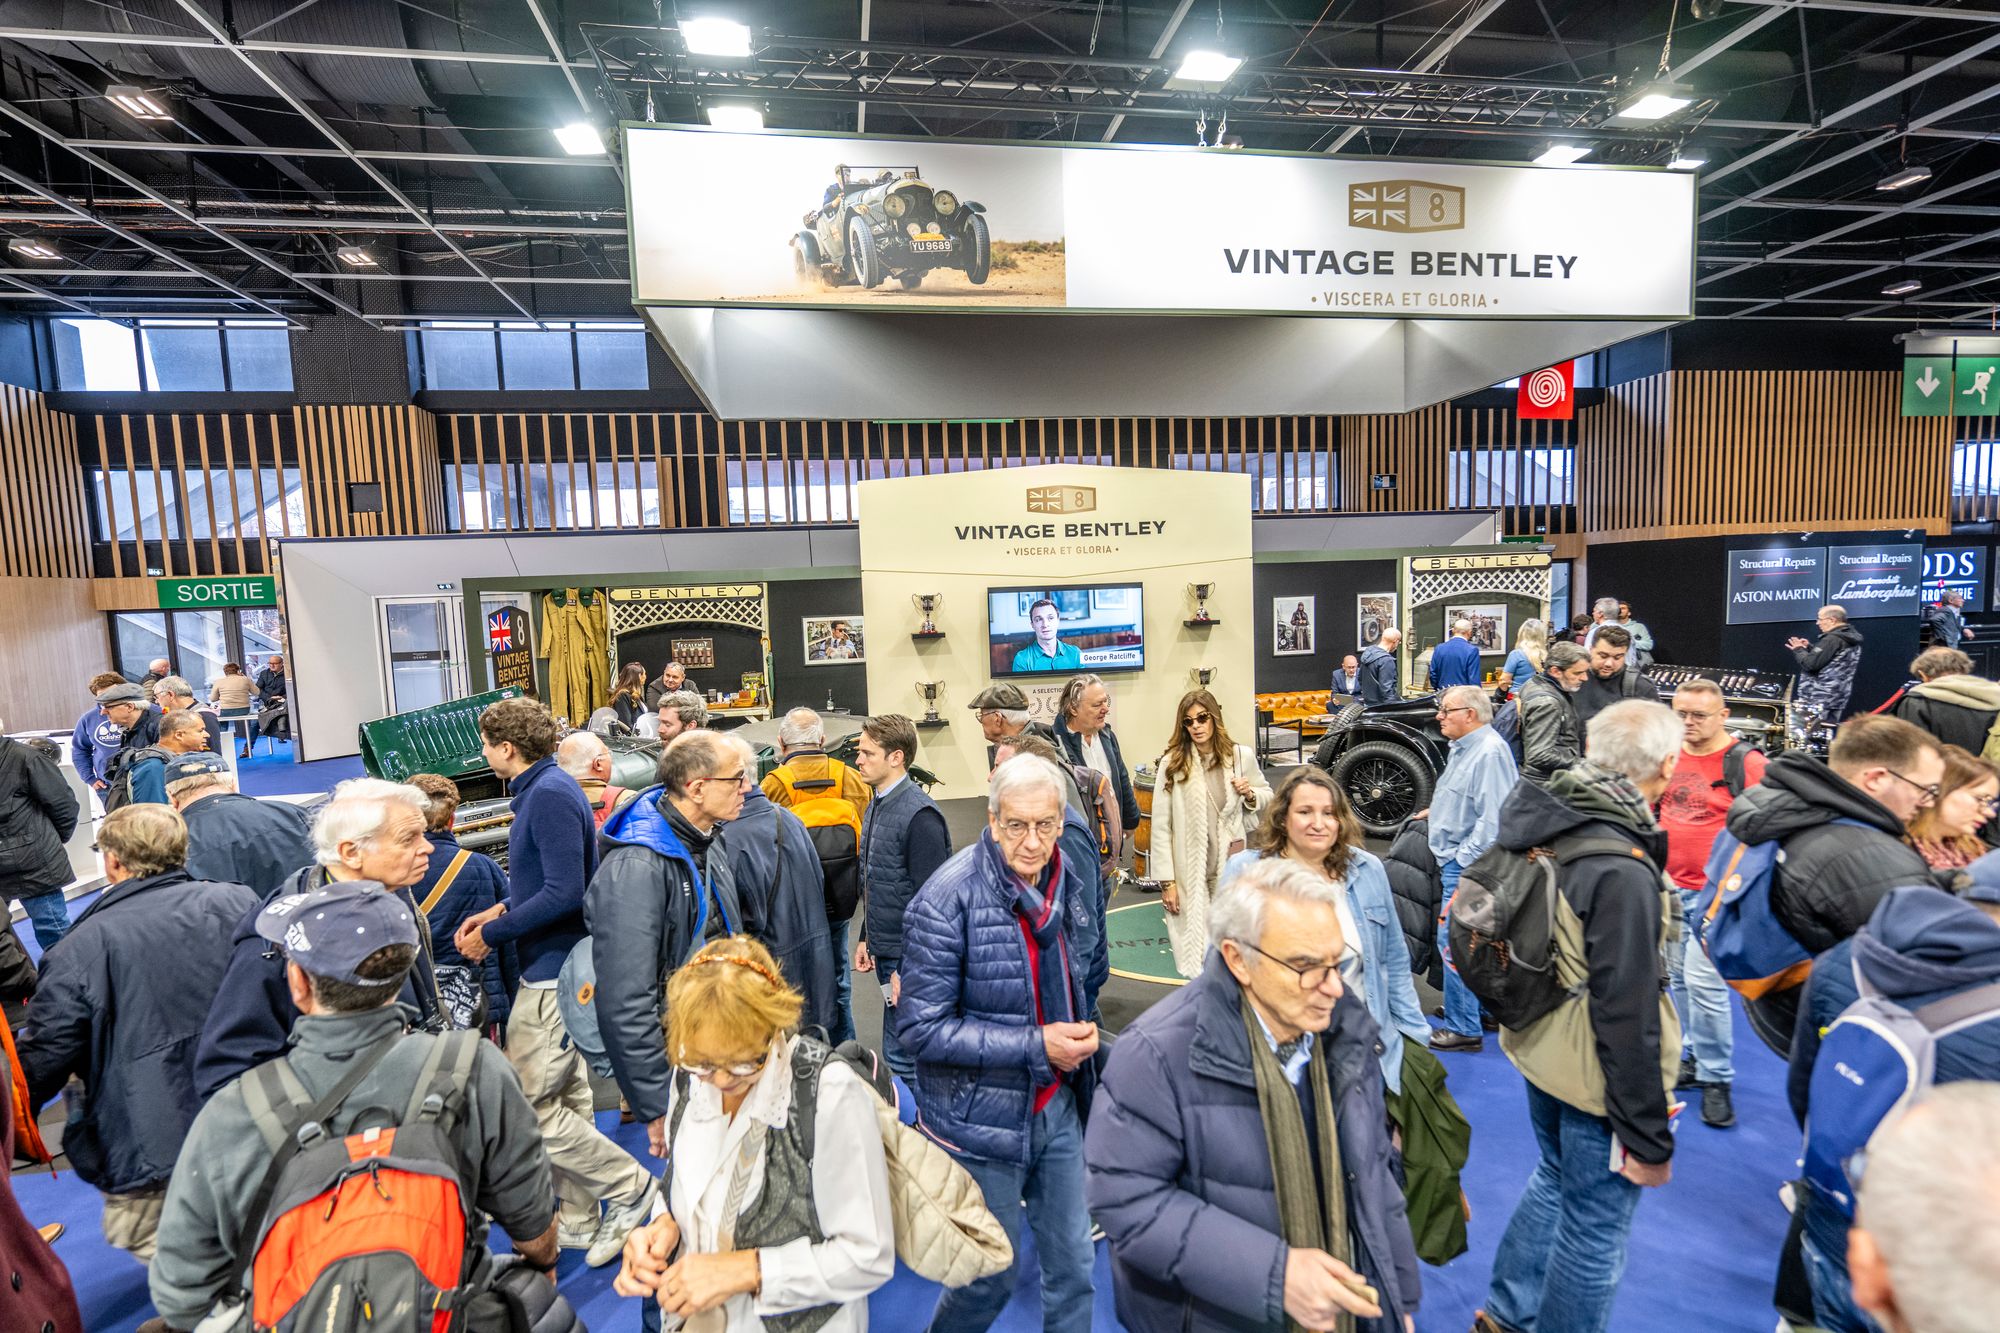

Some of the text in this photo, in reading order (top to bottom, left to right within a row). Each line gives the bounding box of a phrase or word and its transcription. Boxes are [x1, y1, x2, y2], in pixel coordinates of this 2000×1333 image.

[1429, 193, 1444, 222] 8
[912, 241, 951, 251] YU 9689
[1224, 249, 1578, 279] VINTAGE BENTLEY
[1324, 291, 1487, 307] VISCERA ET GLORIA
[1074, 491, 1084, 507] 8
[955, 520, 1166, 540] VINTAGE BENTLEY
[1013, 545, 1112, 556] VISCERA ET GLORIA
[1431, 555, 1535, 569] BENTLEY
[1739, 556, 1816, 569] Structural Repairs
[1839, 553, 1912, 566] Structural Repairs
[177, 583, 264, 602] SORTIE
[630, 587, 744, 599] BENTLEY
[1733, 588, 1820, 603] ASTON MARTIN
[1831, 580, 1918, 602] Lamborghini
[516, 615, 525, 646] 8
[497, 651, 529, 668] VINTAGE
[1109, 652, 1136, 660] Ratcliffe
[498, 664, 530, 683] BENTLEY
